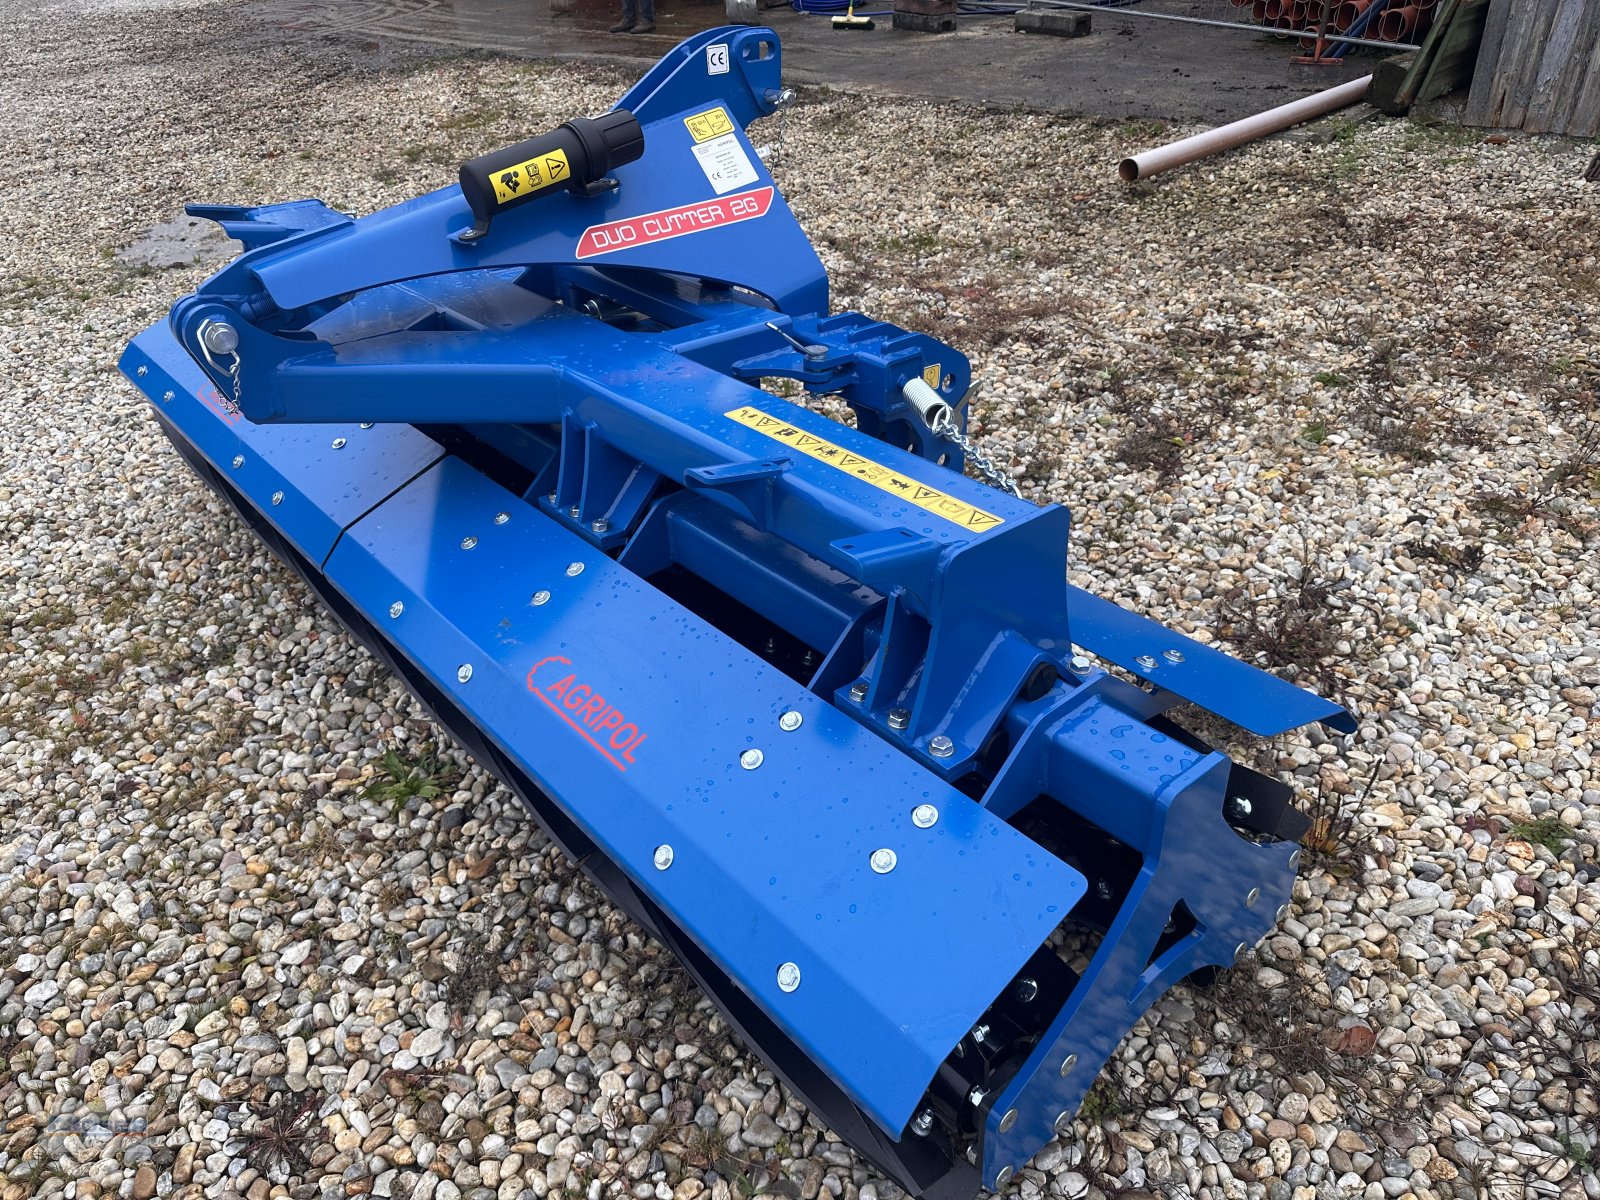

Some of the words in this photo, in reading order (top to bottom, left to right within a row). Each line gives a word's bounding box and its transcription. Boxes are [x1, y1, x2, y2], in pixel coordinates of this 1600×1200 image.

[710, 52, 725, 66] CE
[712, 172, 723, 180] CE
[591, 225, 636, 249] DUO
[643, 205, 725, 237] CUTTER
[729, 197, 759, 216] 2G
[546, 673, 648, 764] AGRIPOL
